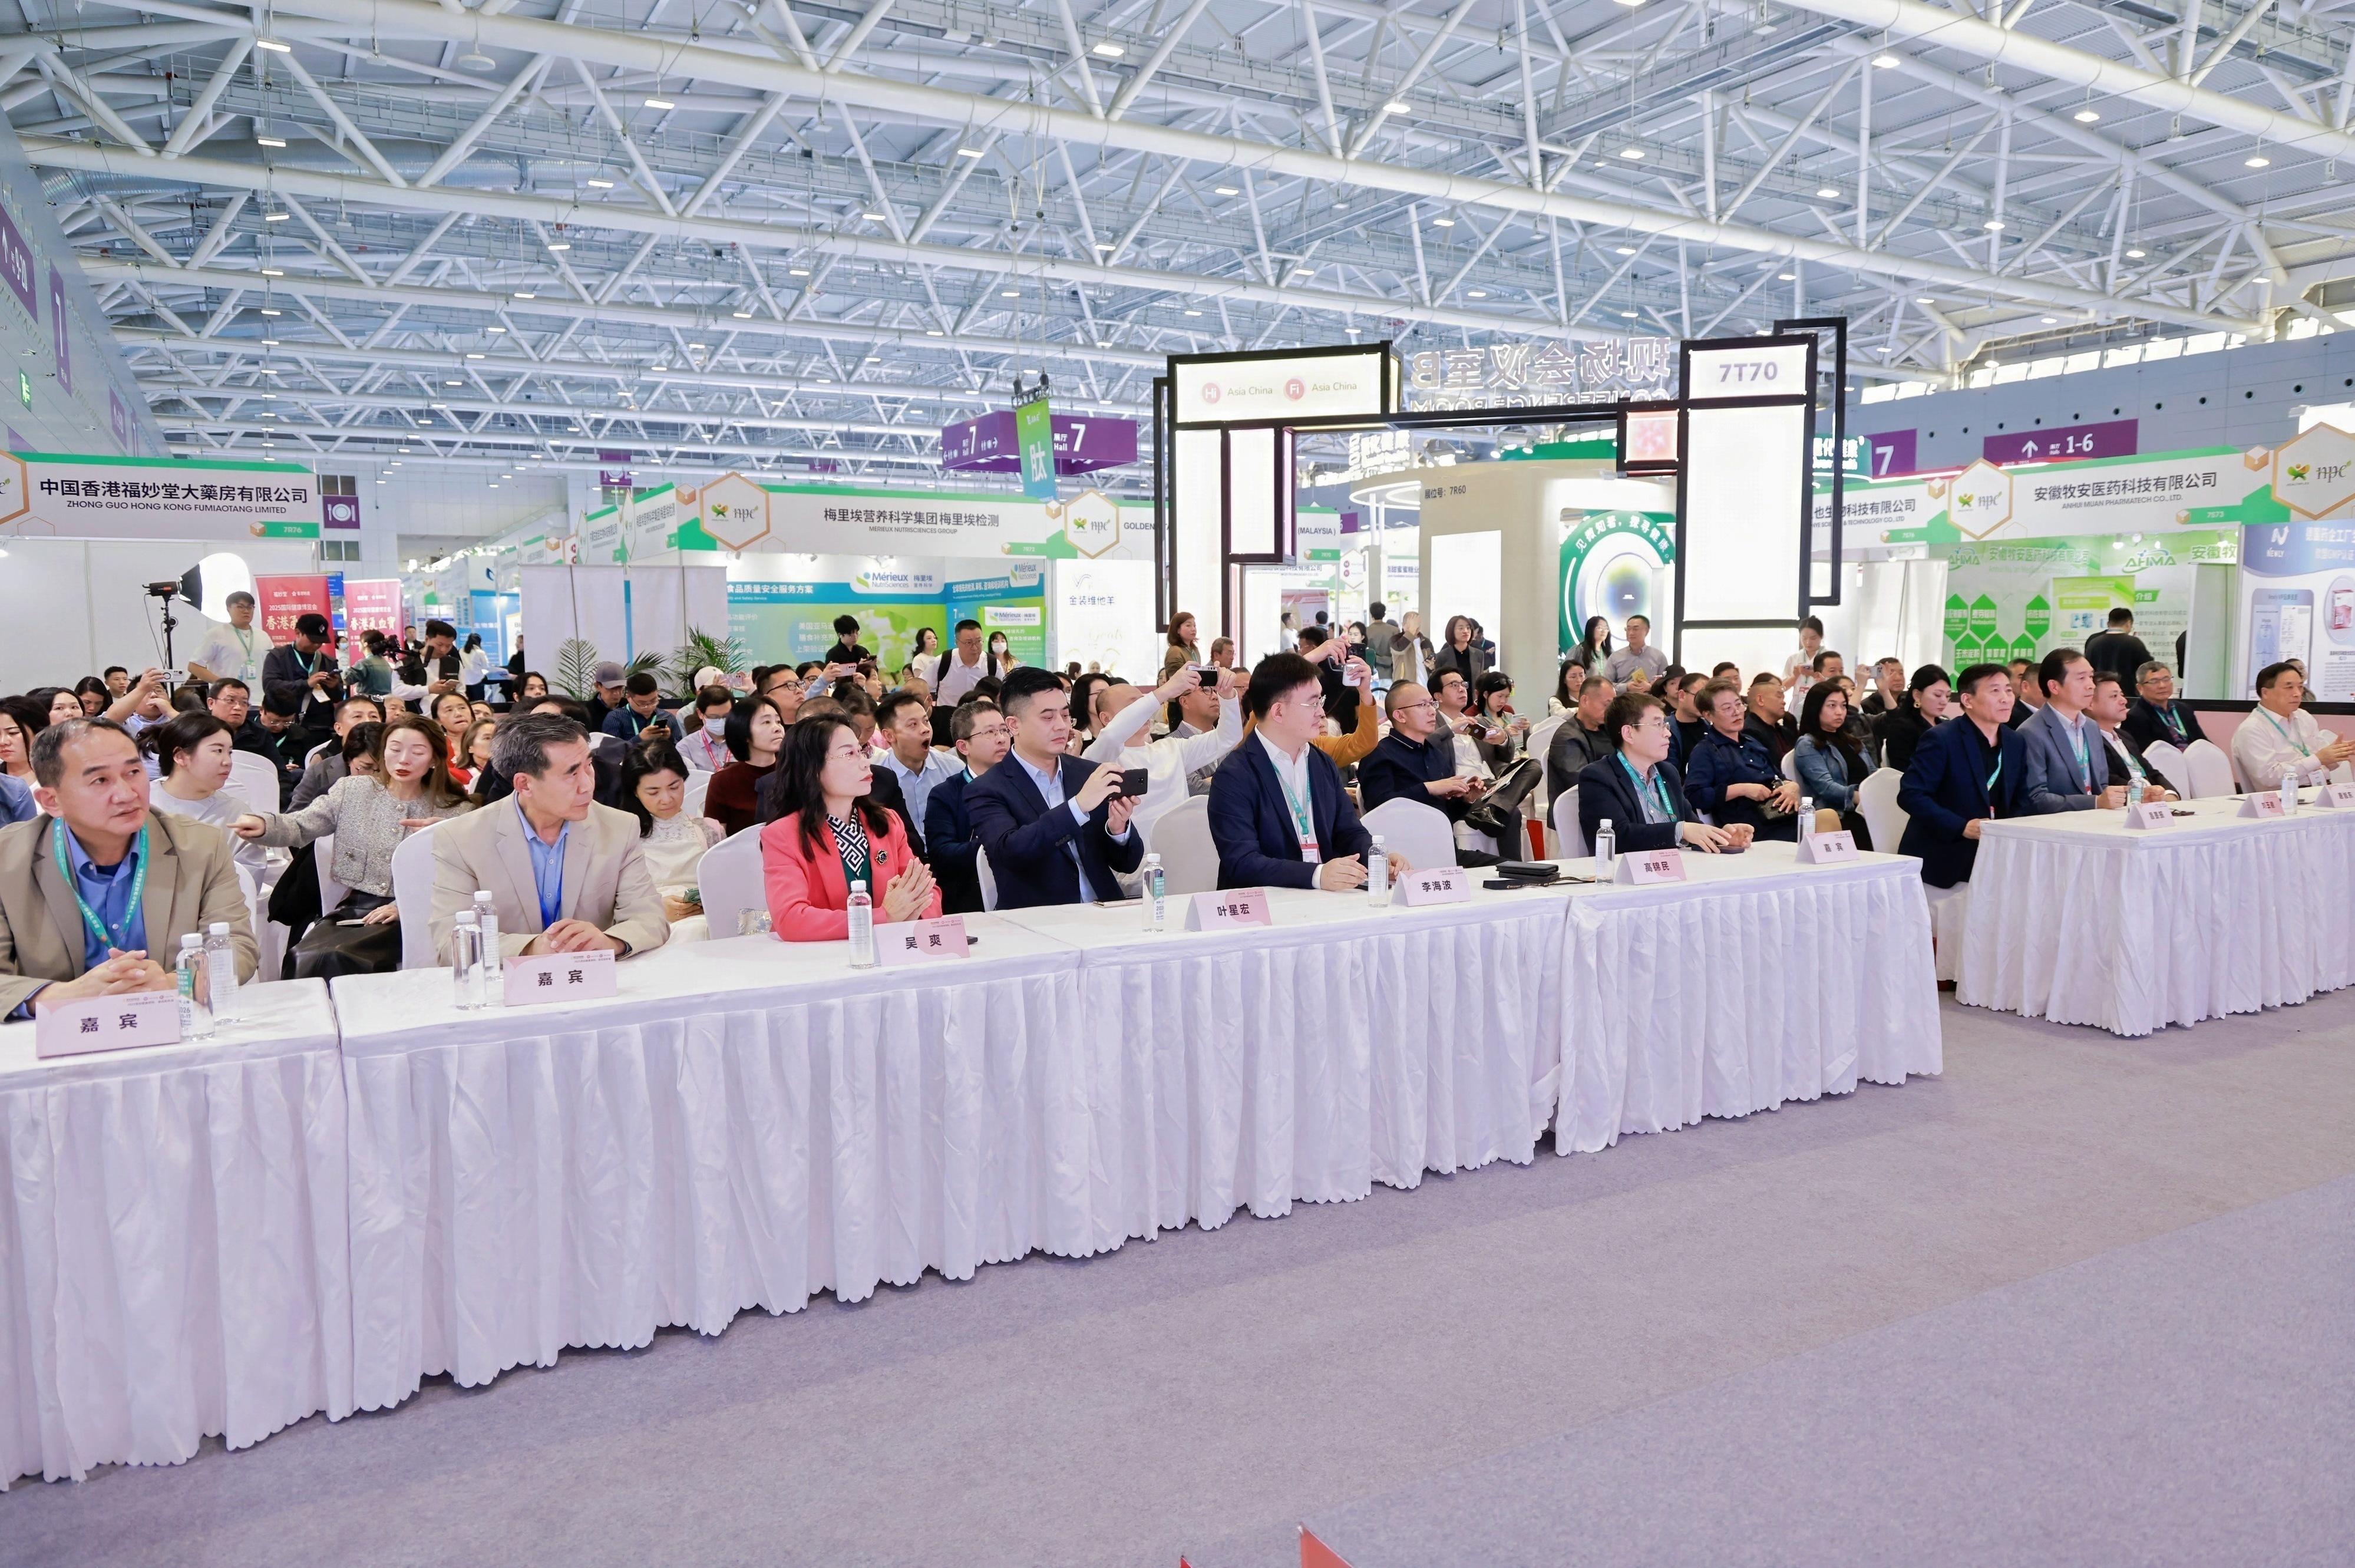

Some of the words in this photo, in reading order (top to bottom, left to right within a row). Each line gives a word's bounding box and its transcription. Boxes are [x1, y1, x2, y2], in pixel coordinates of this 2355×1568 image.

[1719, 361, 1778, 382] 7T70
[1205, 388, 1217, 399] Hi
[1227, 387, 1246, 396] Asia
[1248, 386, 1273, 395] China
[1289, 383, 1300, 394] Fi
[1312, 382, 1330, 392] Asia
[1333, 381, 1357, 391] China
[969, 425, 976, 454] 7
[1053, 433, 1068, 442] 展厅
[1071, 422, 1086, 453] 7
[2066, 433, 2094, 454] 1-6
[1053, 442, 1068, 451] Hall
[1875, 445, 1894, 477] 7
[40, 478, 308, 504] 中国香港福妙堂大藥房有限公司
[2034, 472, 2217, 501] 安徽牧安医药科技有限公司
[194, 504, 253, 513] FUMIAOTANG
[2062, 501, 2083, 510] ANHUI
[2105, 496, 2151, 507] PHARMATECH
[824, 508, 937, 525] 梅里埃营养科学集团
[940, 512, 999, 527] 梅里埃检测
[1848, 517, 1882, 526] TECHNOLOGY
[1124, 522, 1155, 530] GOLDEN
[2191, 544, 2237, 560] 安徽牧
[1018, 563, 1037, 573] Mérieux
[873, 572, 909, 582] Mérieux
[1069, 596, 1115, 606] 金装维他羊
[1422, 879, 1453, 892] 李海波
[1217, 903, 1250, 917] 叶星宏
